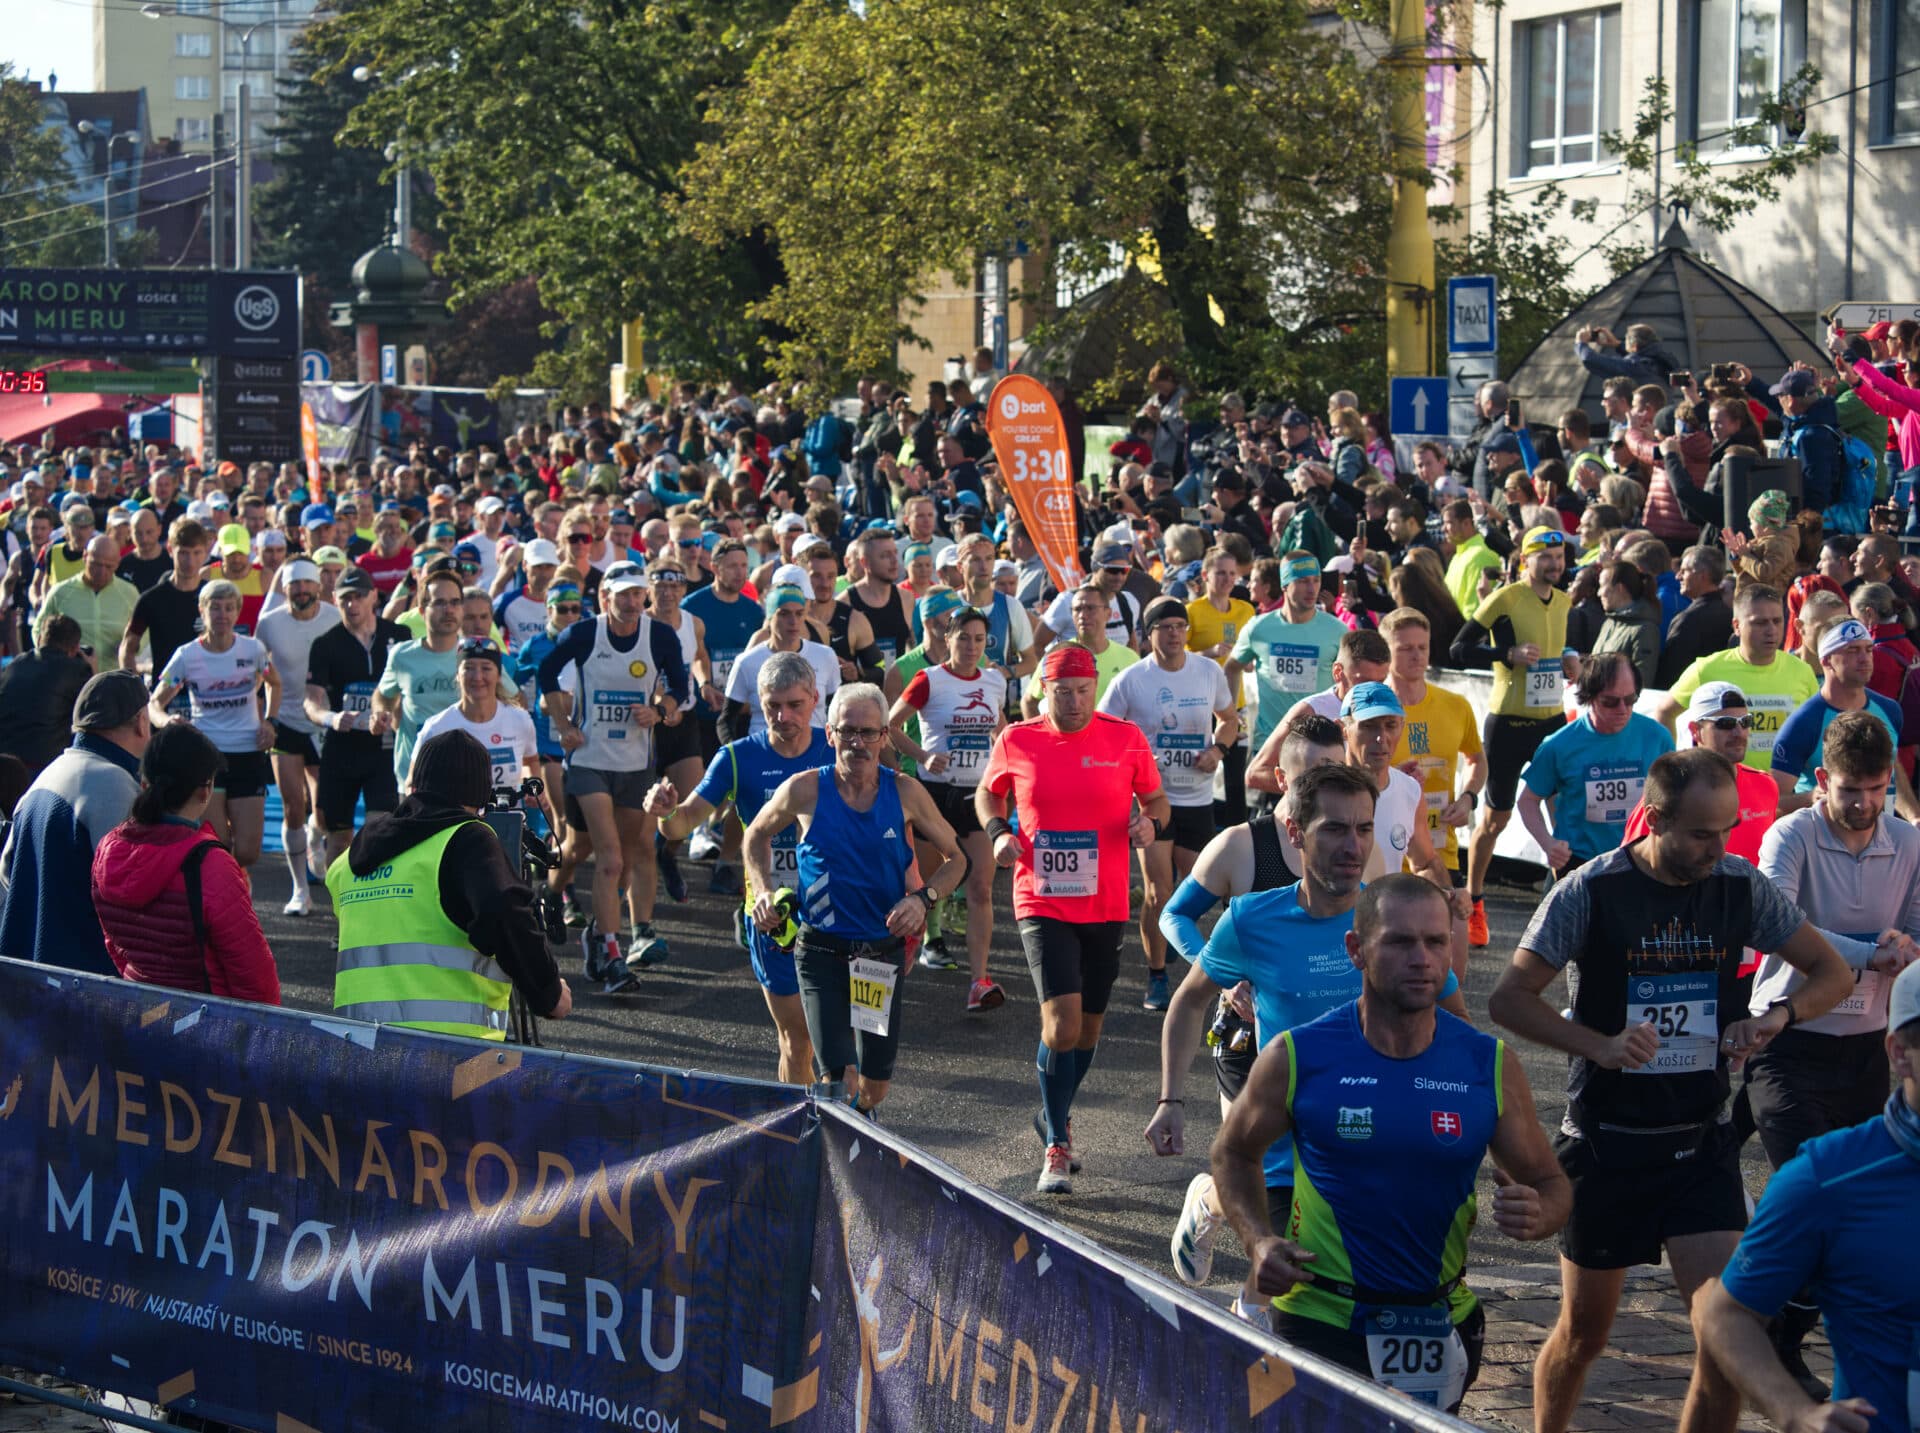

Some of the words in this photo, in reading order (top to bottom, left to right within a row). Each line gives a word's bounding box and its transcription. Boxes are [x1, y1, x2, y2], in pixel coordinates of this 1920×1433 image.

[35, 308, 125, 329] MIERU
[1457, 304, 1487, 325] TAXI
[0, 371, 44, 392] 0:36
[1021, 401, 1047, 413] bart
[1013, 449, 1067, 481] 3:30
[1276, 658, 1304, 675] 865
[1534, 673, 1555, 689] 378
[351, 697, 371, 712] 10
[597, 706, 632, 722] 1197
[953, 715, 976, 724] Run
[980, 715, 995, 724] DK
[949, 750, 980, 768] F117
[1163, 750, 1192, 767] 340
[1595, 781, 1627, 802] 339
[1043, 851, 1078, 873] 903
[1308, 954, 1329, 962] BMW
[1310, 965, 1348, 973] MARATHON
[854, 979, 882, 1008] 111/1
[1642, 1004, 1690, 1038] 252
[1657, 1053, 1697, 1067] KOŠICE
[1336, 1126, 1373, 1134] ORAVA
[423, 1245, 685, 1373] MIERU
[48, 1267, 102, 1299] KOŠICE
[144, 1293, 219, 1331] NAJSTARŠÍ
[220, 1311, 230, 1332] V
[234, 1316, 305, 1350] EURÓPE
[317, 1335, 373, 1364] SINCE
[376, 1348, 414, 1374] 1924
[1381, 1337, 1444, 1374] 203
